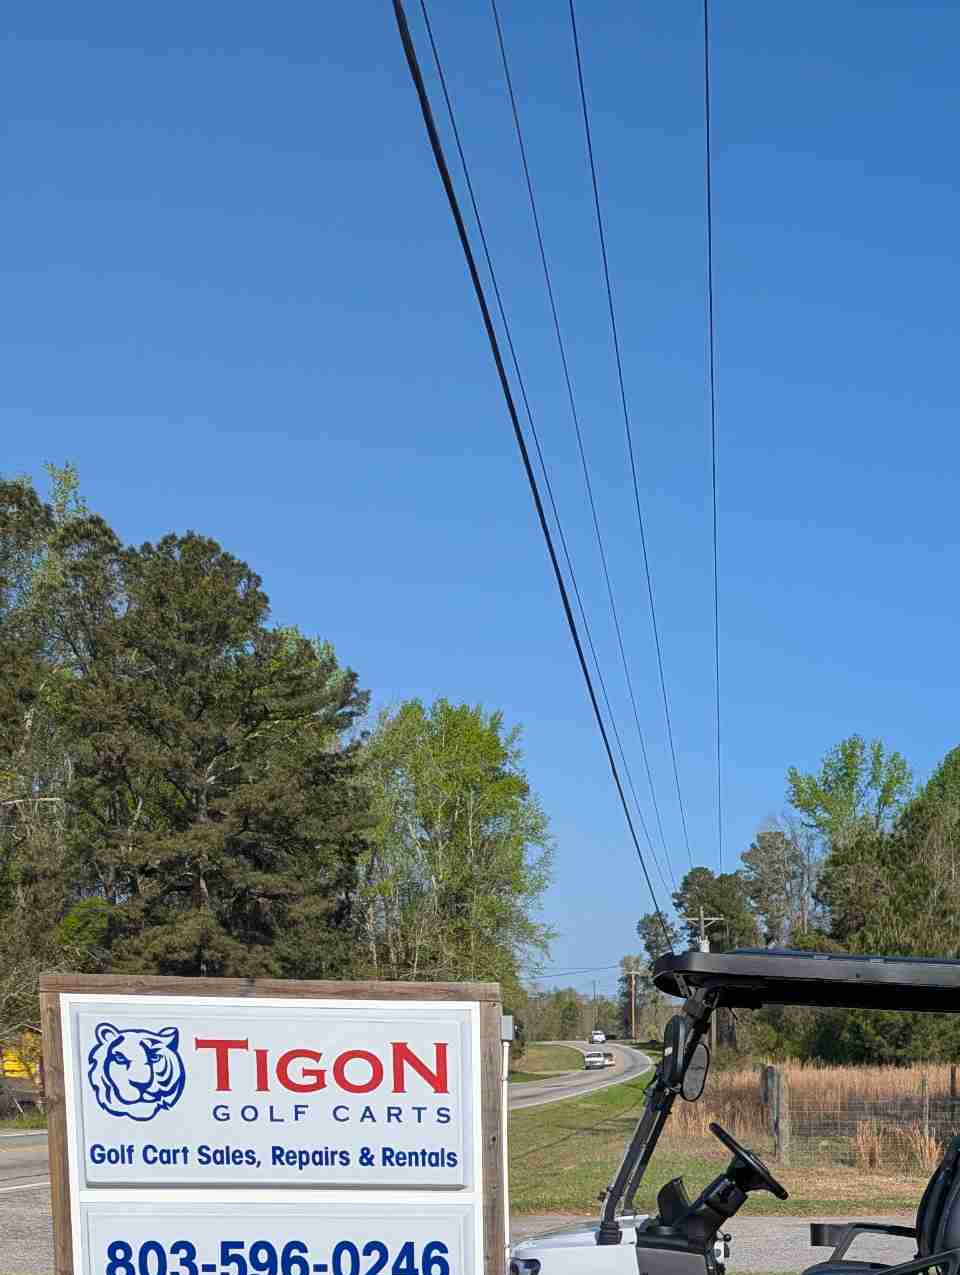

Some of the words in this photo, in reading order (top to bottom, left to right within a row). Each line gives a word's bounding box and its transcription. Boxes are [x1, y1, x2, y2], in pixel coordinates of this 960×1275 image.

[194, 1037, 449, 1094] TIGON
[212, 1104, 309, 1123] GOLF
[332, 1105, 451, 1124] CARTS
[89, 1143, 135, 1165] Golf
[142, 1144, 190, 1165] Cart
[197, 1144, 261, 1169] Sales,
[271, 1145, 351, 1171] Repairs
[358, 1146, 375, 1167] &
[381, 1146, 458, 1168] Rentals
